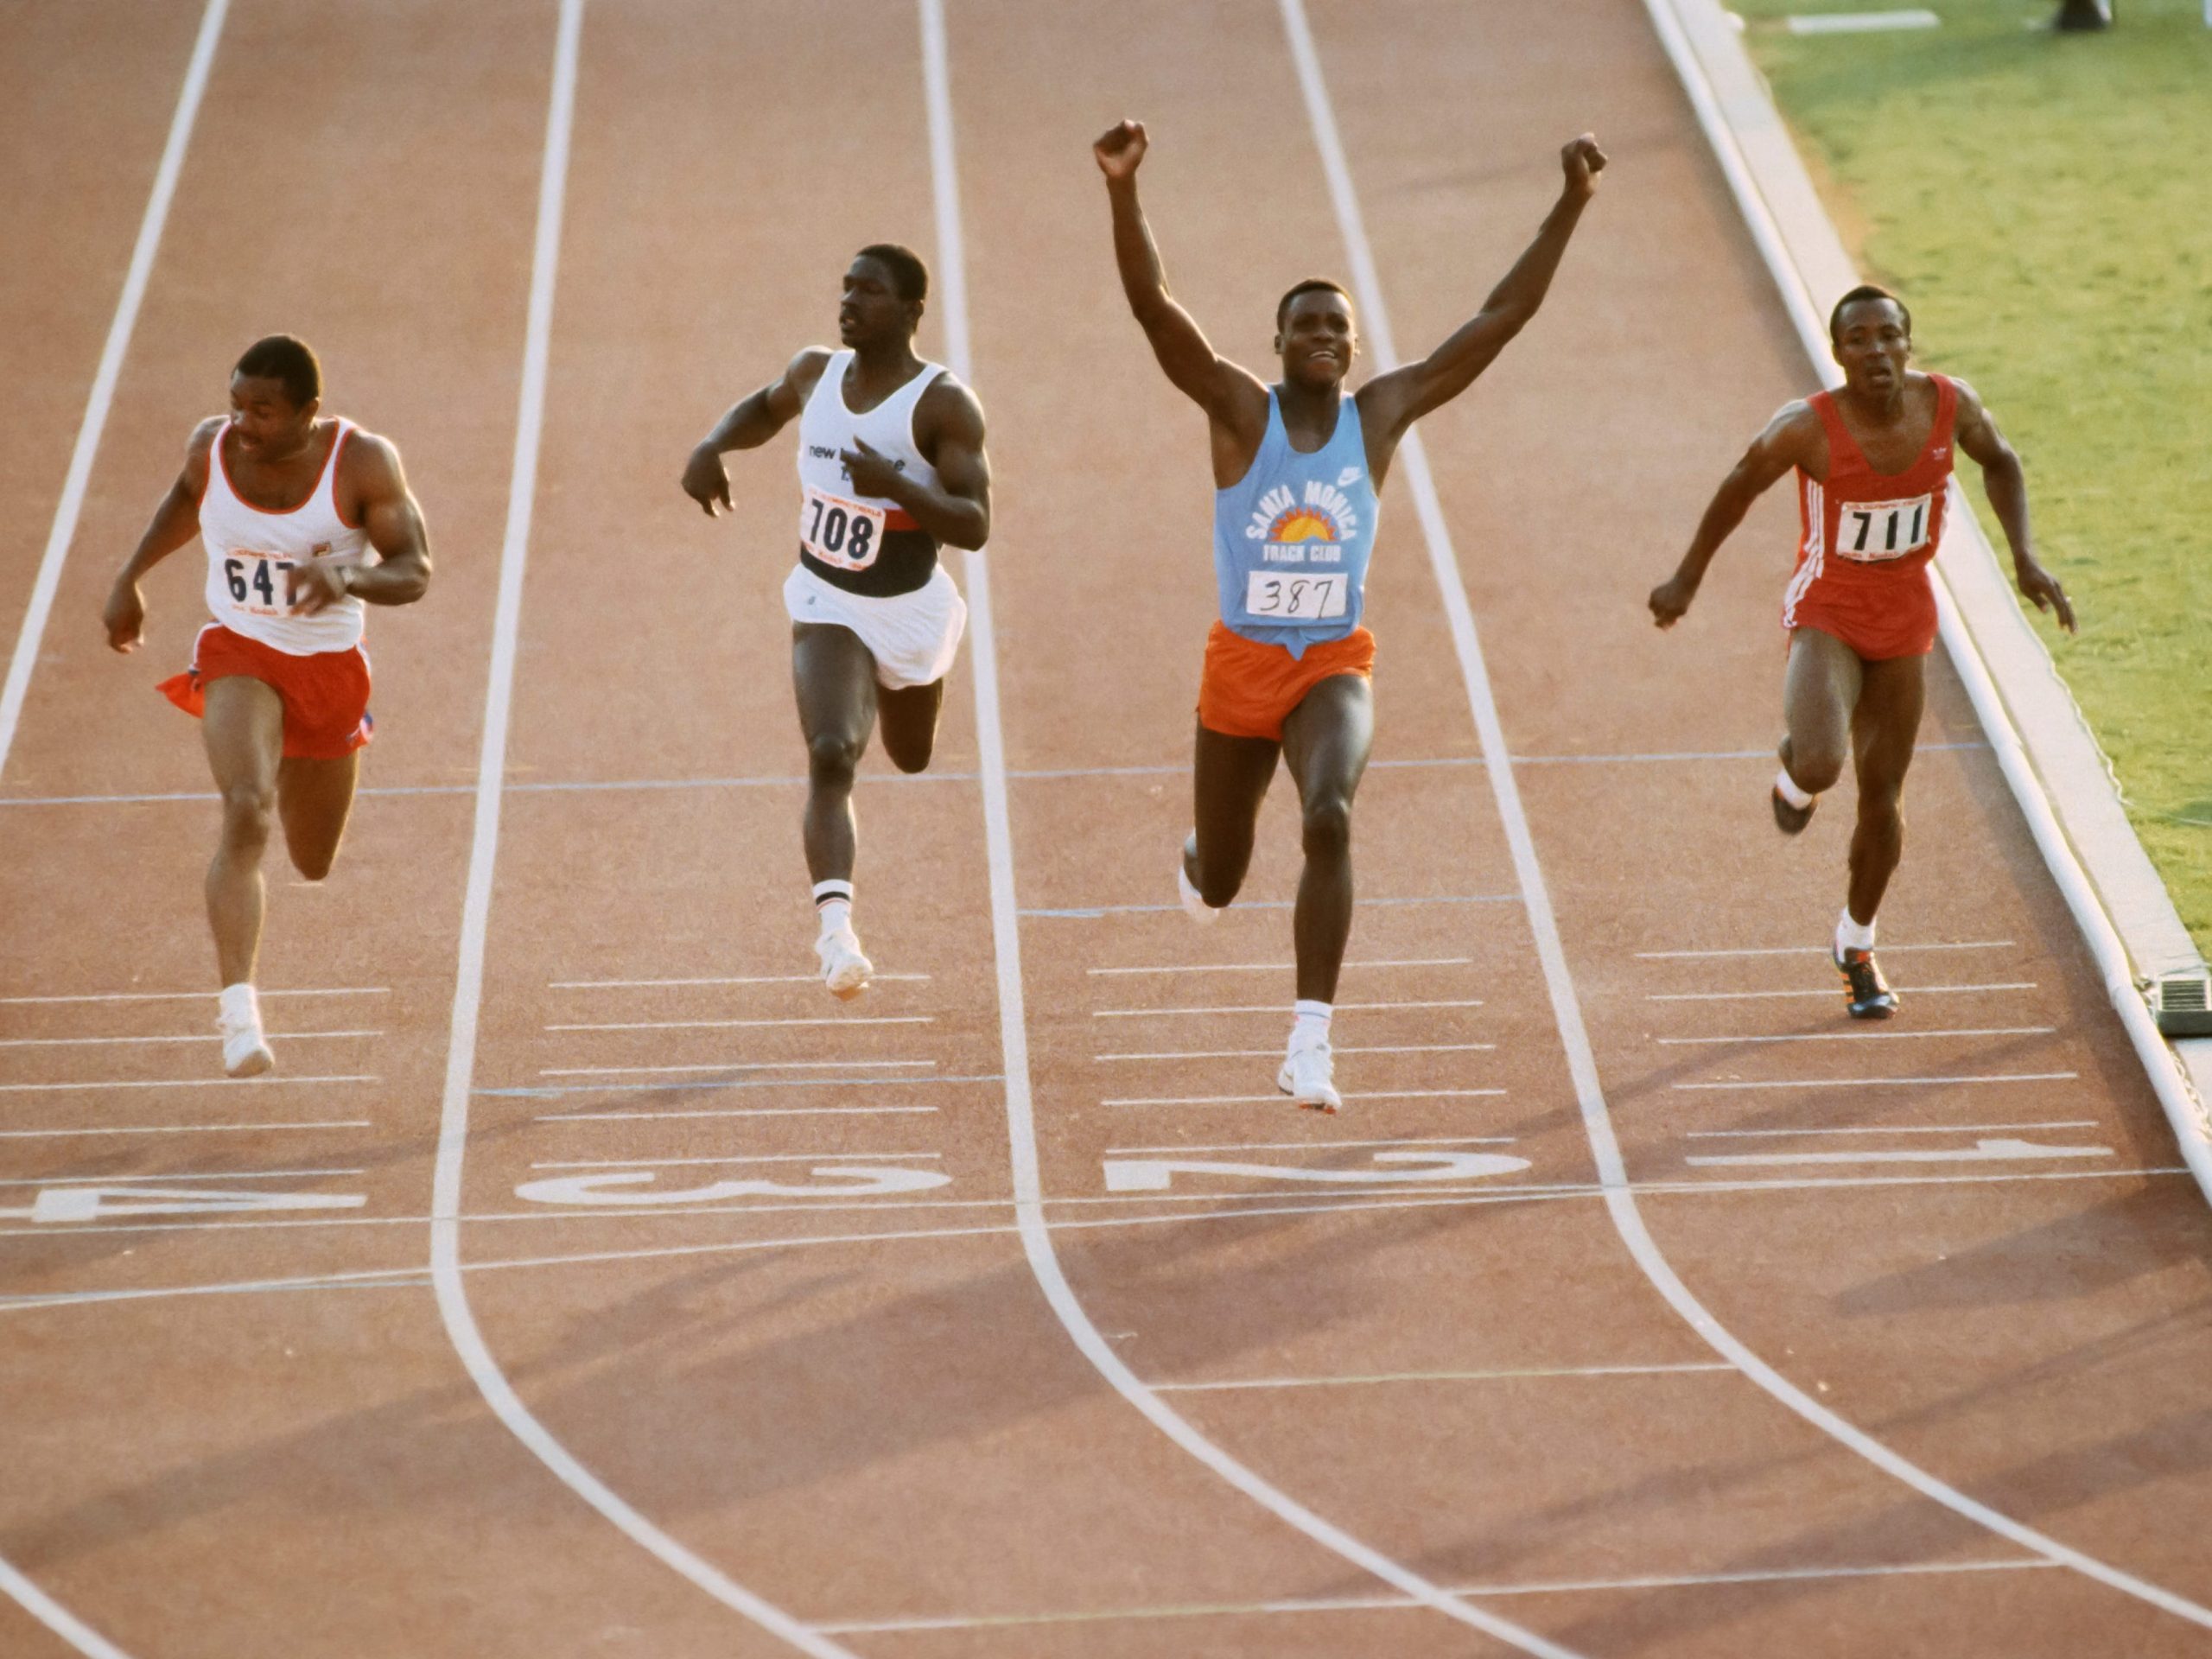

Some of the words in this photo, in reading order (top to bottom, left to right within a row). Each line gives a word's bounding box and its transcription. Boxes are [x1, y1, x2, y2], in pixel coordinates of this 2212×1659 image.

[809, 445, 836, 460] new
[810, 498, 874, 560] 708
[1245, 484, 1296, 539] SANTA
[1304, 480, 1357, 540] MONICA
[1853, 504, 1923, 550] 711
[1262, 544, 1305, 562] TRACK
[1310, 544, 1342, 562] CLUB
[1260, 579, 1333, 620] 387
[1103, 1152, 1532, 1192] 2
[1685, 1139, 2114, 1166] 1
[513, 1166, 952, 1205] 3
